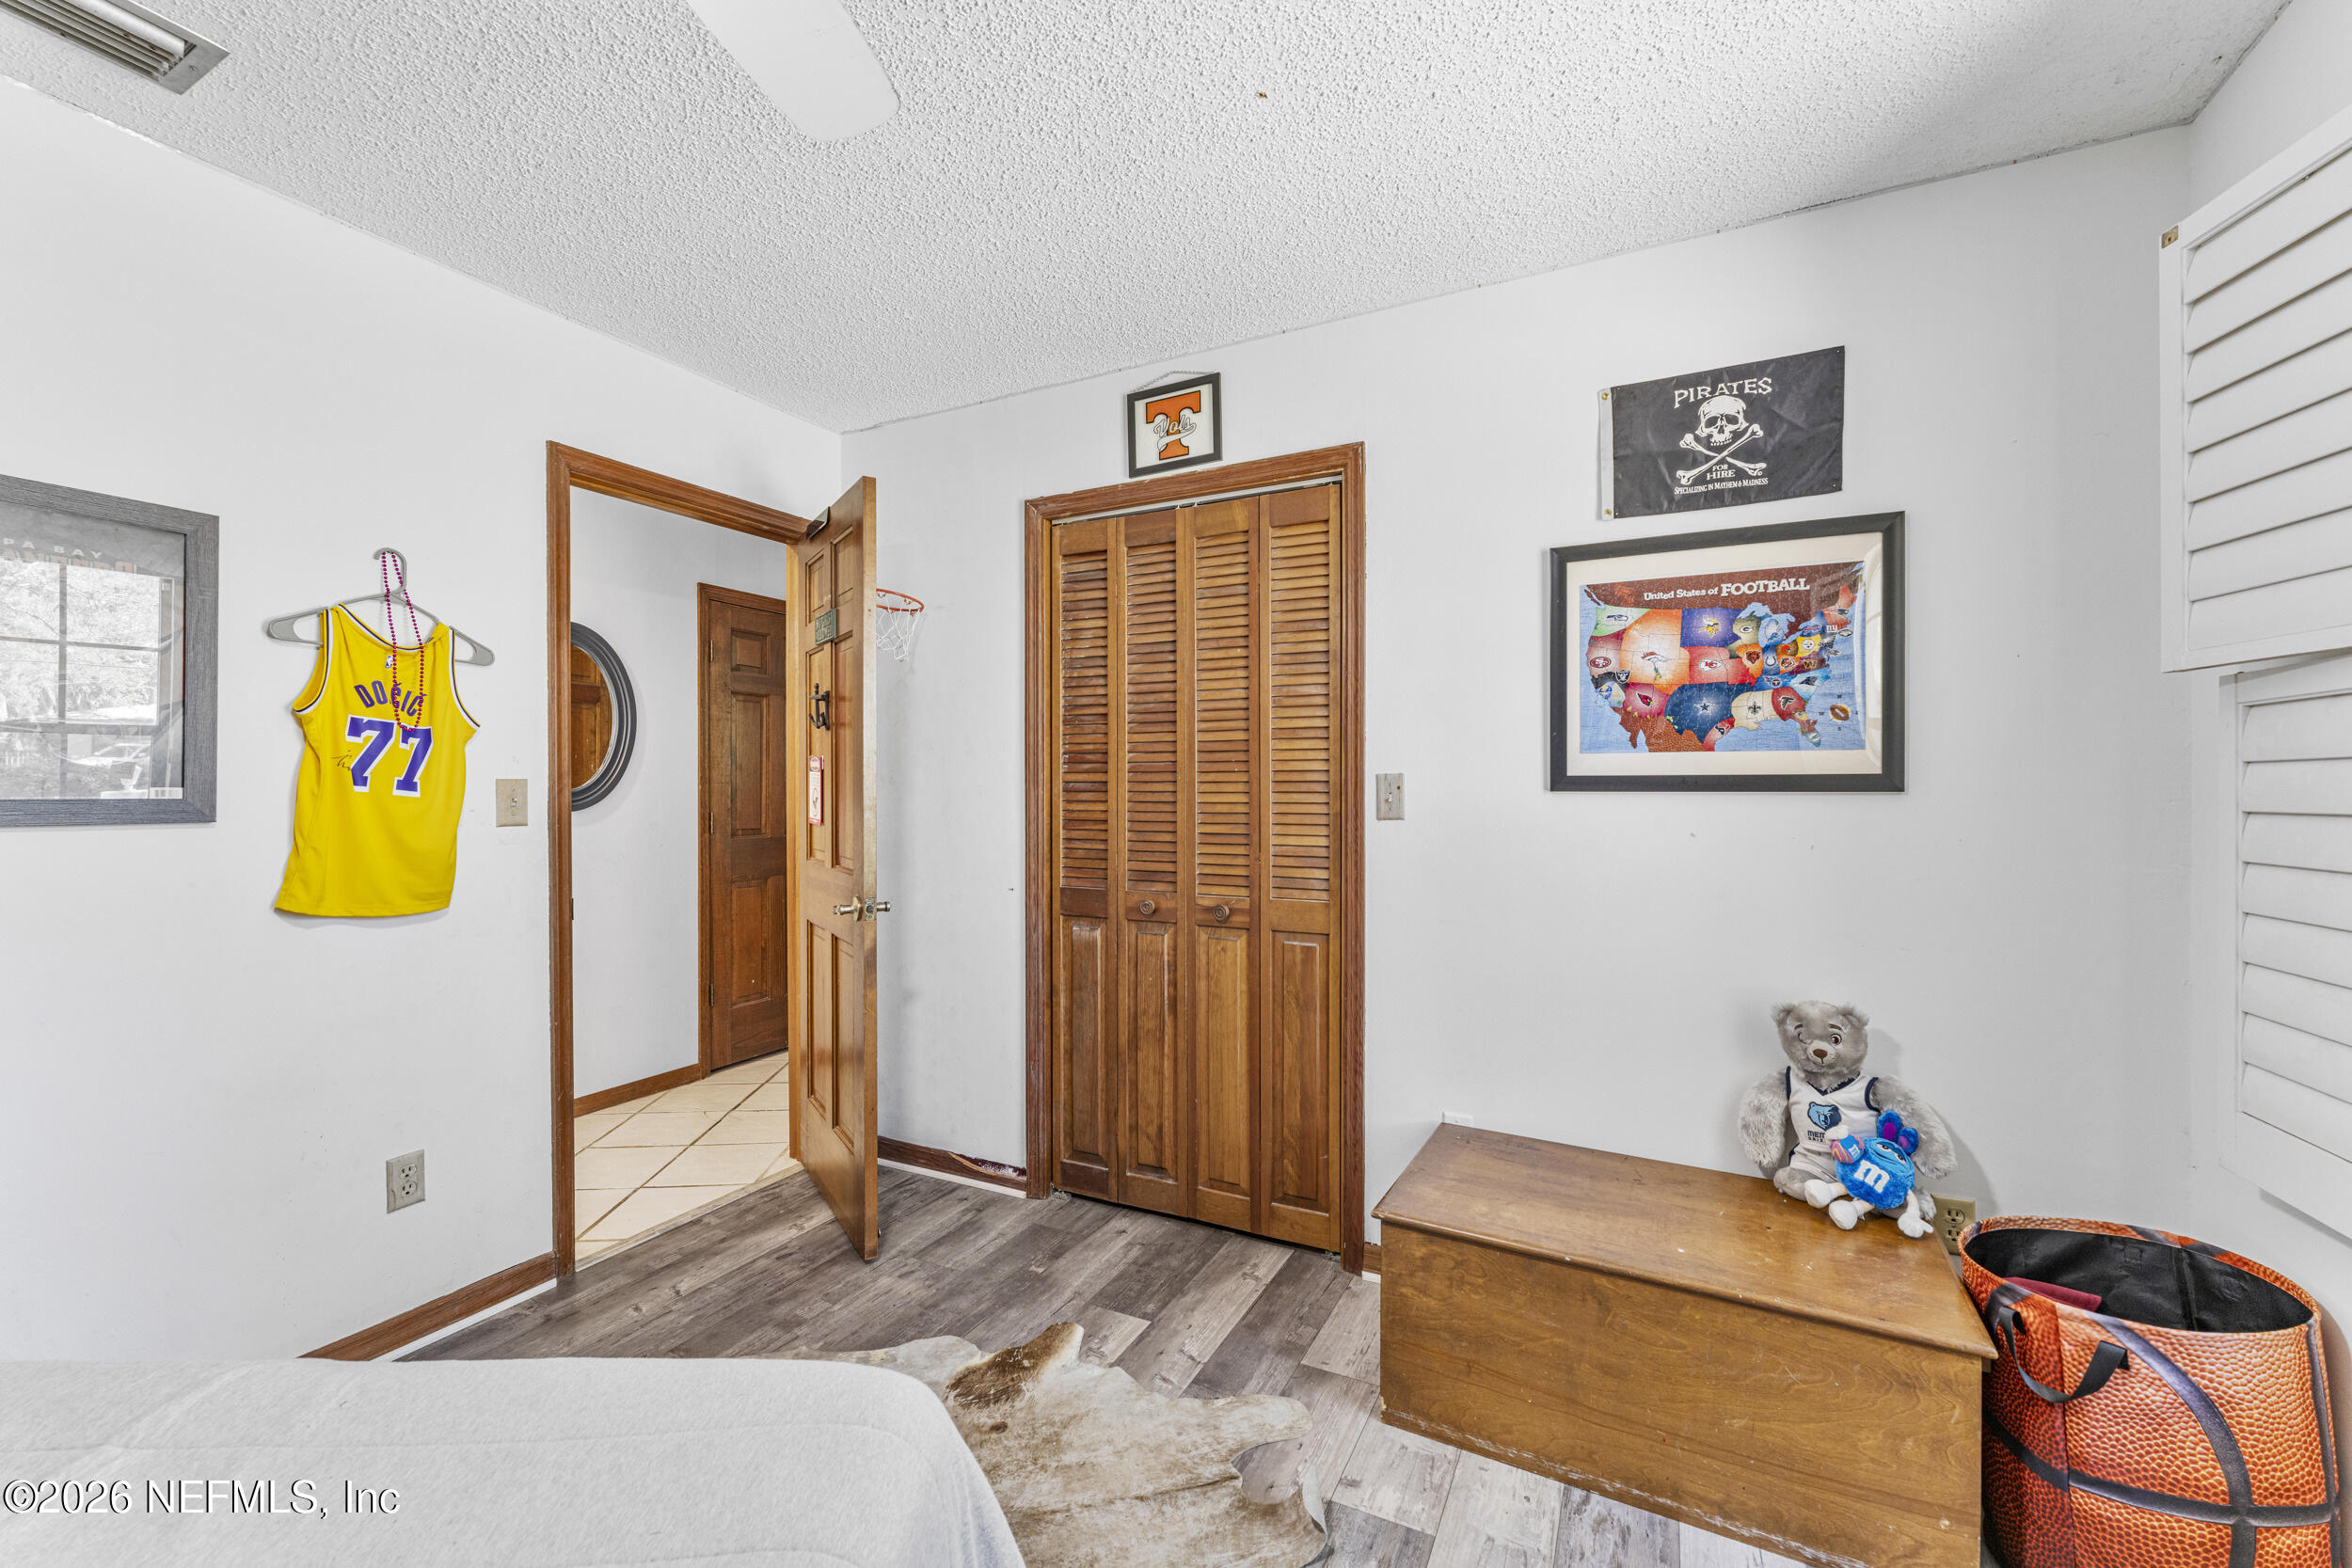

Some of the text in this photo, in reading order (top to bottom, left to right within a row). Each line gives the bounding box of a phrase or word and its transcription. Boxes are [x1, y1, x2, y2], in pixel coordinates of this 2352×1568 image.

[1674, 377, 1772, 409] PIRATES
[1153, 415, 1196, 444] Vols
[1706, 469, 1736, 480] HIRE
[53, 546, 102, 559] BAY
[1644, 578, 1810, 601] United States of FOOTBALL
[345, 714, 434, 798] 77
[1849, 1144, 1860, 1159] m
[1853, 1160, 1890, 1194] m
